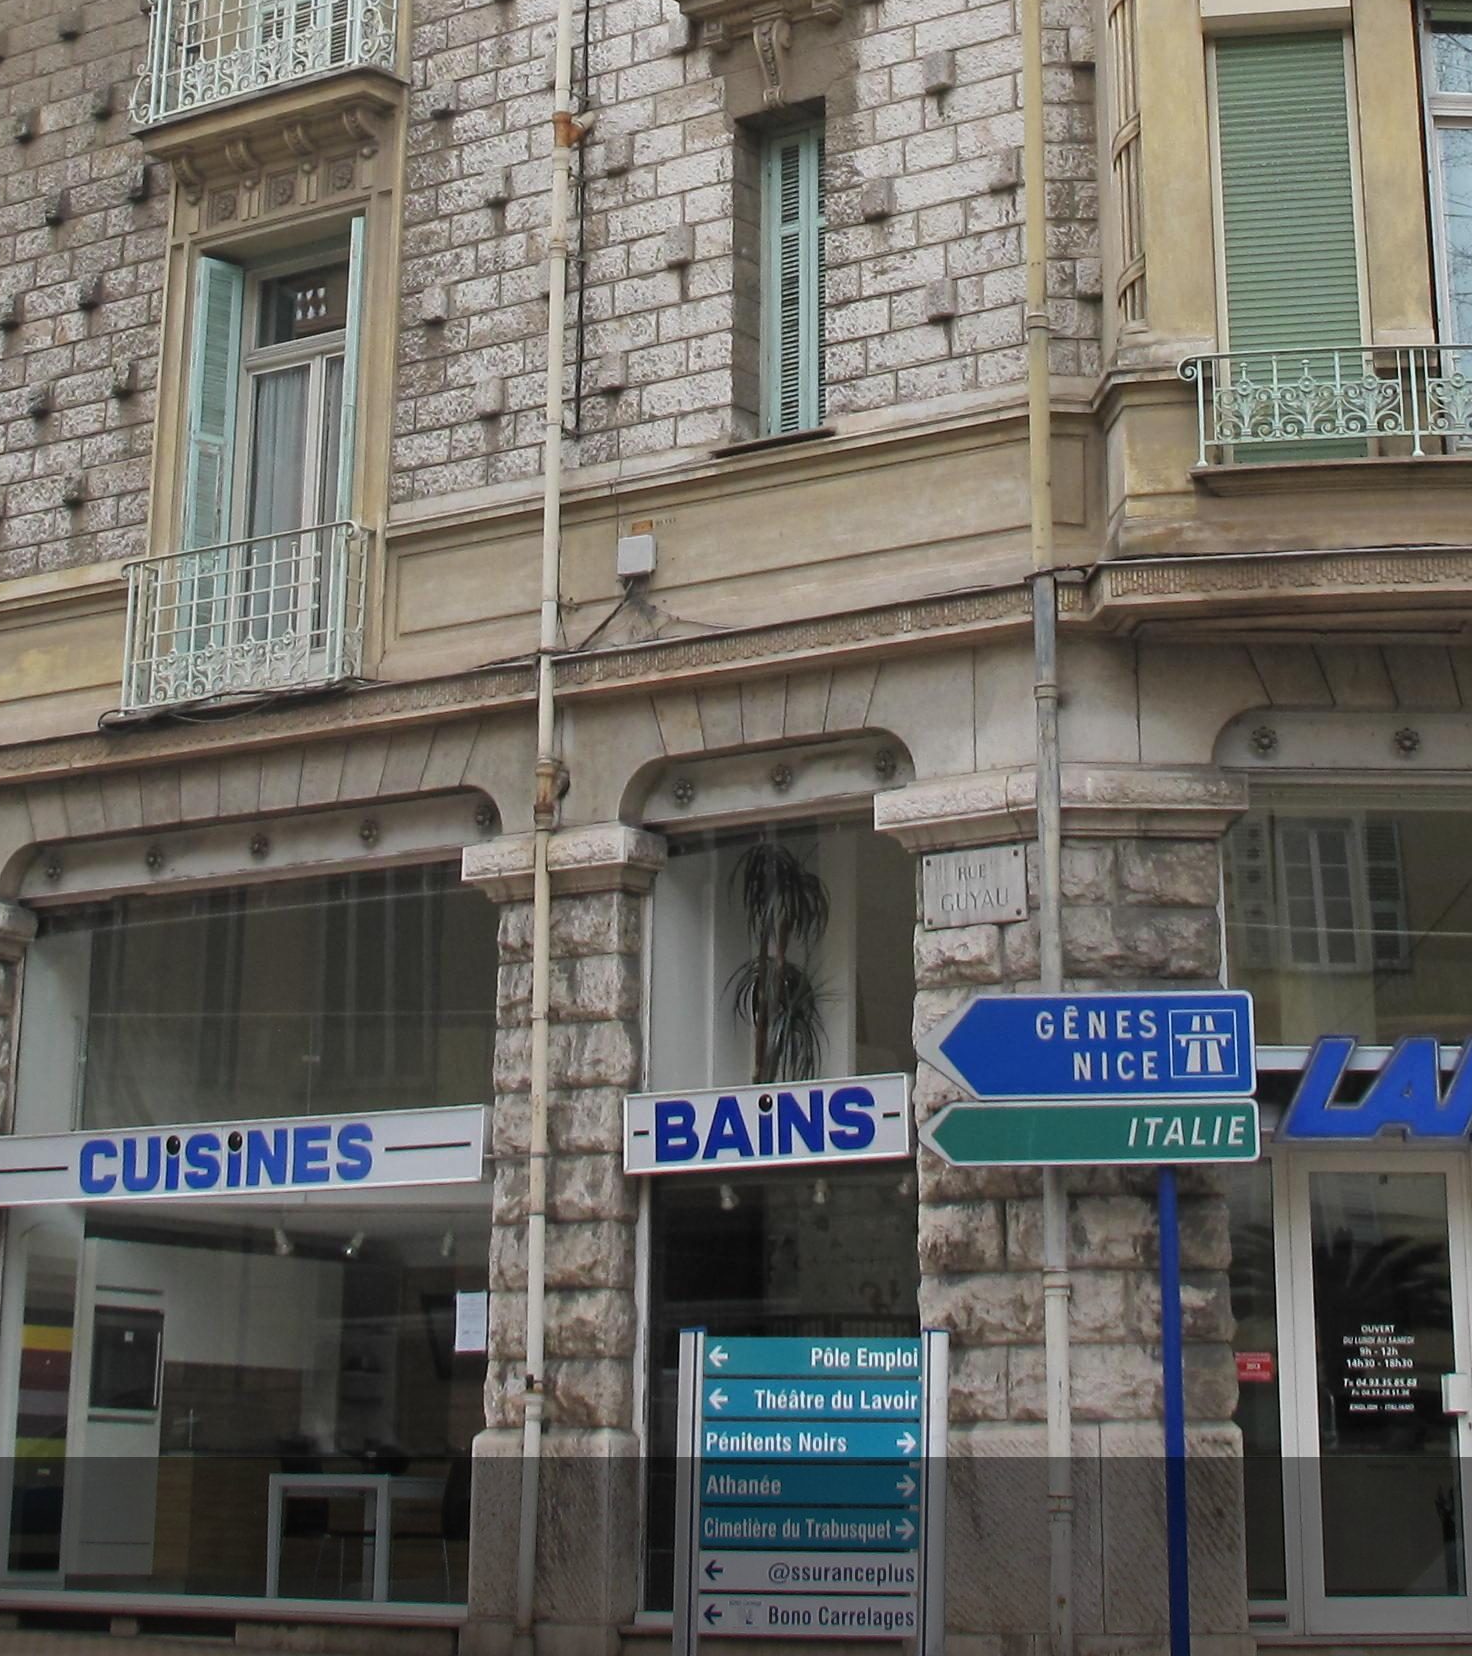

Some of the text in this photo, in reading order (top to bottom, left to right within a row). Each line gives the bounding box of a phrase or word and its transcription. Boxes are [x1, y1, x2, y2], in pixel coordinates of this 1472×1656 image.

[957, 864, 986, 881] RUE
[940, 887, 1009, 912] GUYAU
[1036, 1005, 1158, 1040] GÊNES
[1073, 1050, 1159, 1081] NICE
[1128, 1116, 1246, 1147] ITALIE
[1360, 1324, 1396, 1334] OUVERT
[810, 1347, 919, 1371] Pôle Emploi
[1347, 1358, 1376, 1368] 14h30
[1384, 1358, 1414, 1368] 18h30
[1359, 1346, 1372, 1357] 9h
[1381, 1346, 1399, 1357] 12h
[754, 1388, 918, 1410] Théâtre du Lavoir
[705, 1432, 848, 1453] Pénitents Noirs
[705, 1474, 782, 1495] Athanée
[703, 1517, 892, 1543] Cimetière du Trabusquet
[767, 1562, 915, 1587] @ssuranceplus
[768, 1605, 915, 1630] Bono Carrelages
